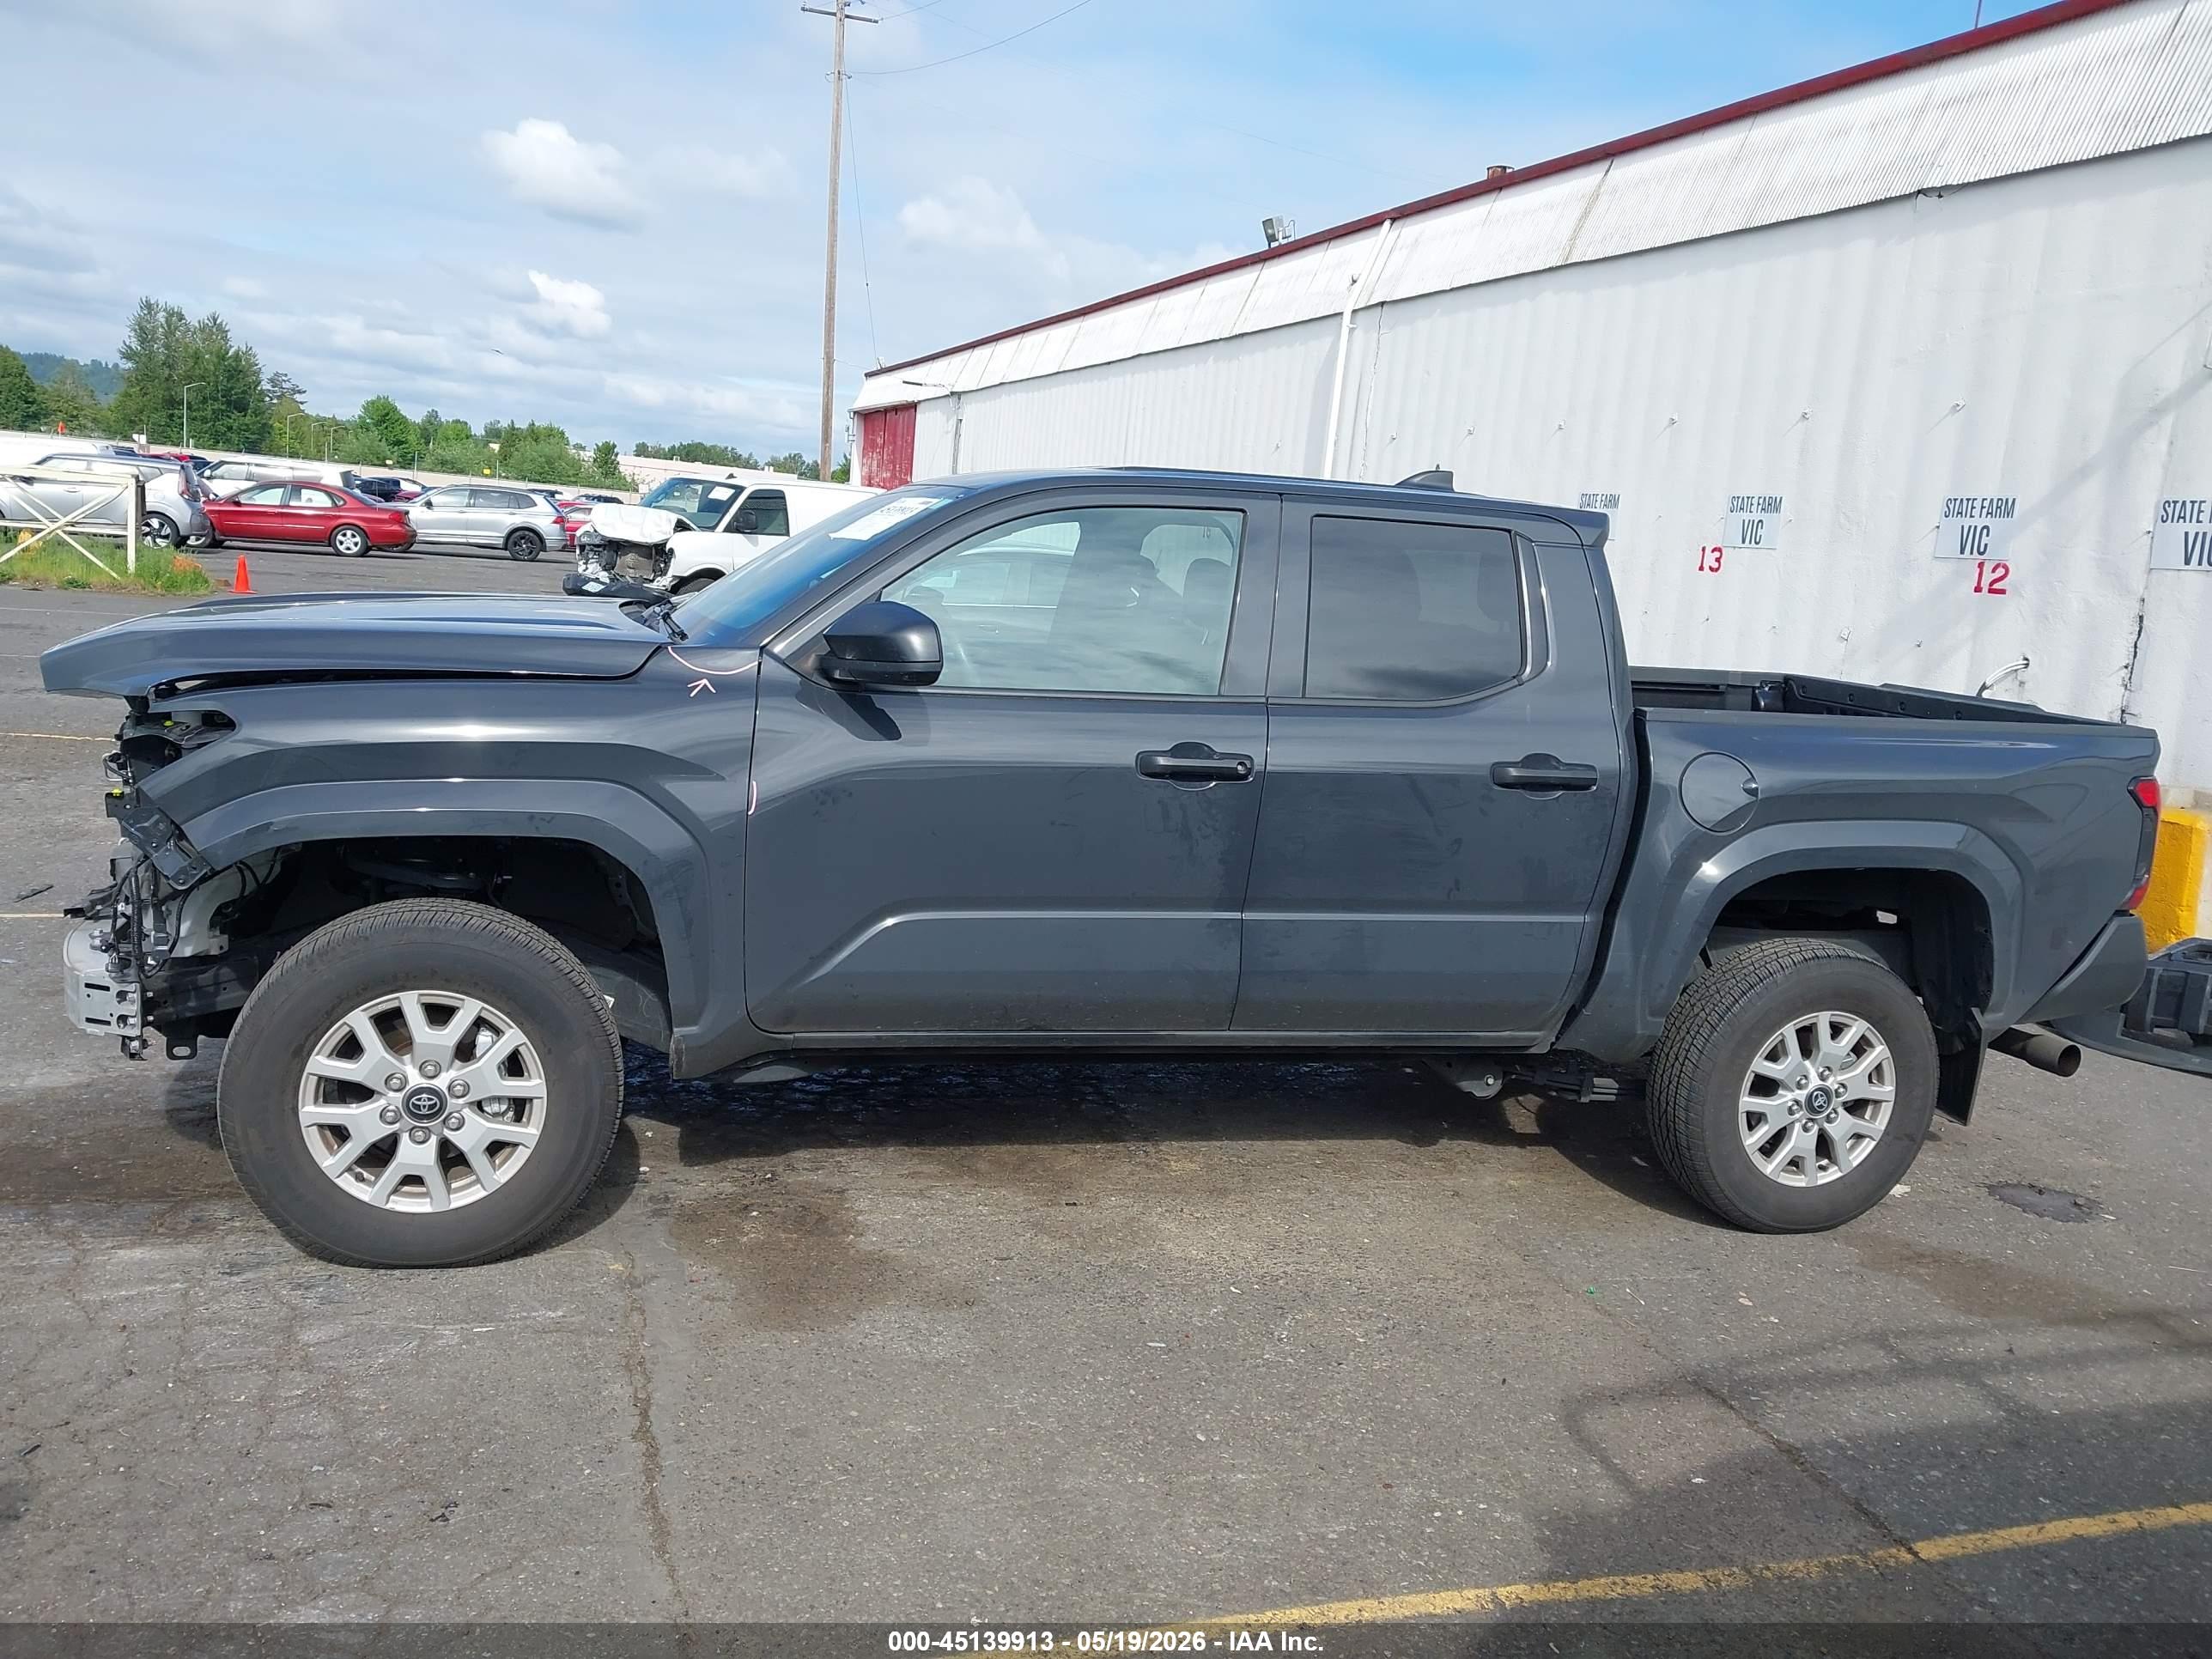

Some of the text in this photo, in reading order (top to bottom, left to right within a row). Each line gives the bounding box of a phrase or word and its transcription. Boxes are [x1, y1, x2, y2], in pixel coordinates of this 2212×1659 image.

[1579, 493, 1620, 509] STATE FARM
[1729, 495, 1784, 514] STATE FARM
[1943, 497, 2017, 519] STATE FARM
[2160, 500, 2207, 524] STATE
[1741, 519, 1765, 545] VIC
[1959, 524, 1990, 556] VIC
[1698, 545, 1723, 573] 13
[1973, 561, 2010, 595] 12
